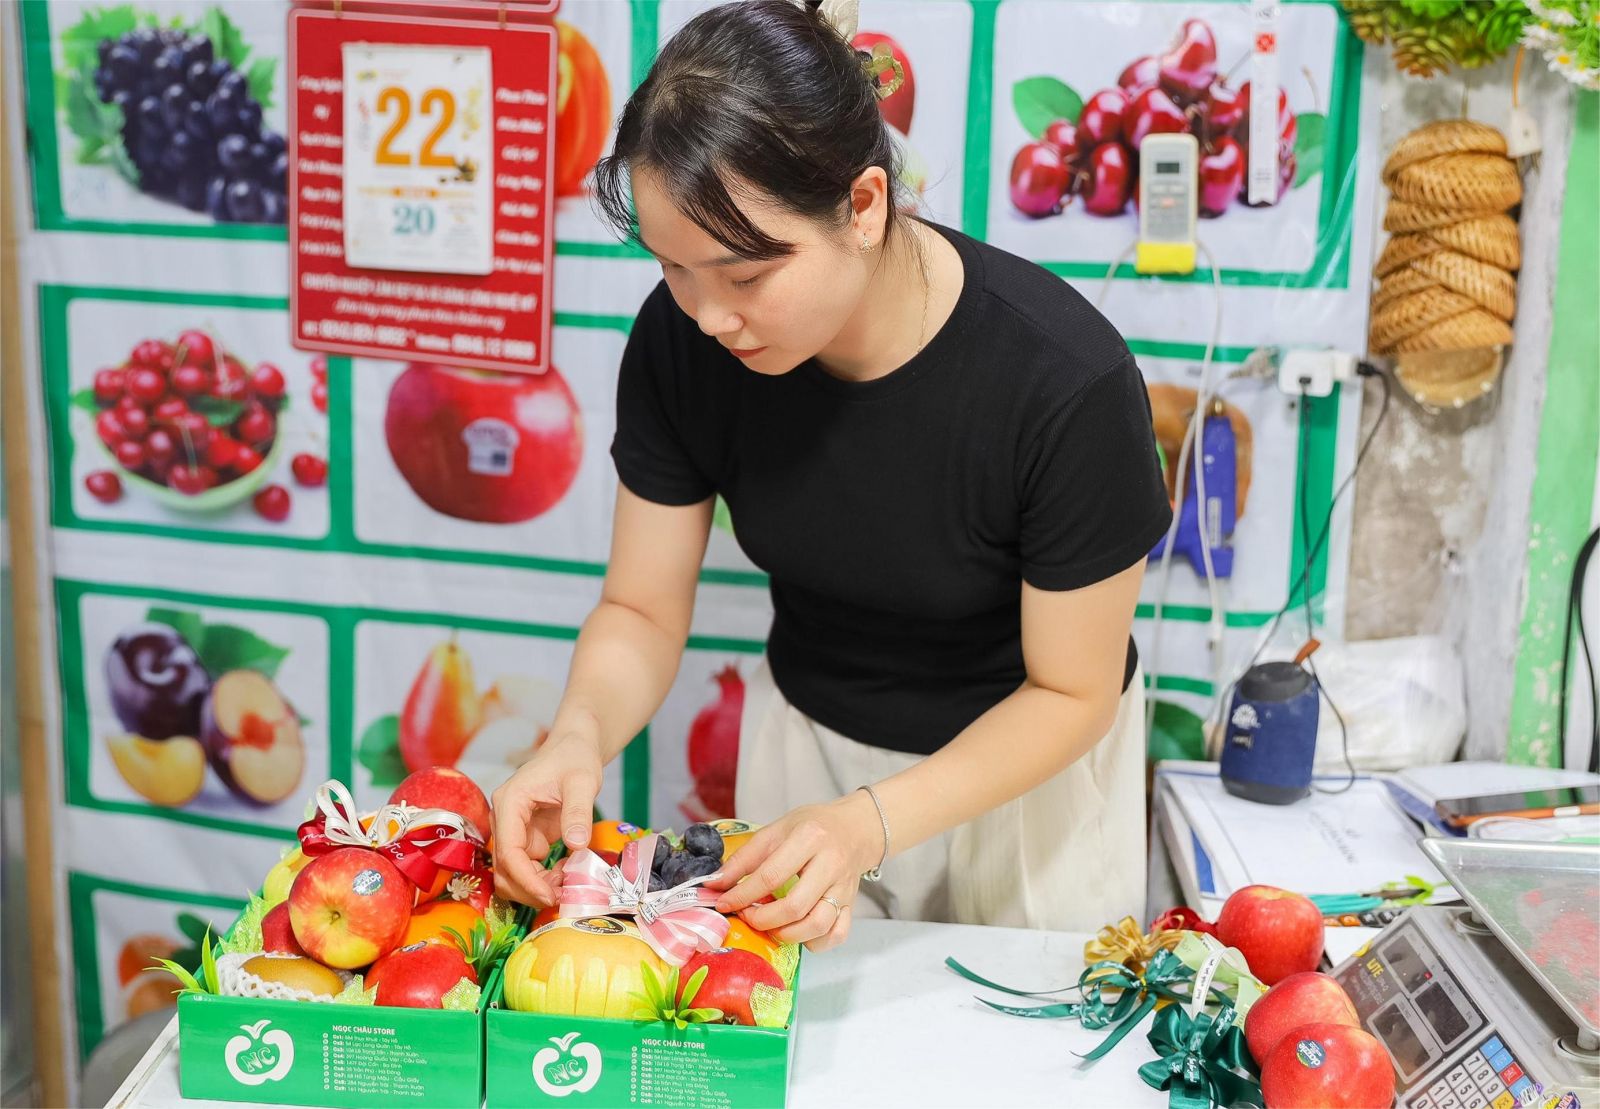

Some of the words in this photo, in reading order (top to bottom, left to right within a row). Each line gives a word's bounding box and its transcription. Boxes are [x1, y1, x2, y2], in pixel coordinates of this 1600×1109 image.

[375, 86, 457, 167] 22
[393, 204, 436, 235] 20
[1298, 1041, 1321, 1066] dazzle
[241, 1047, 275, 1072] NC
[1468, 1056, 1480, 1066] 7
[548, 1059, 583, 1084] NC
[1452, 1072, 1462, 1082] 4
[1477, 1069, 1489, 1080] 8
[1434, 1086, 1445, 1096] 1
[1460, 1084, 1472, 1095] 5
[1487, 1083, 1499, 1094] 9
[1417, 1099, 1428, 1109] 0
[1442, 1099, 1454, 1109] 2
[1470, 1098, 1481, 1109] 6
